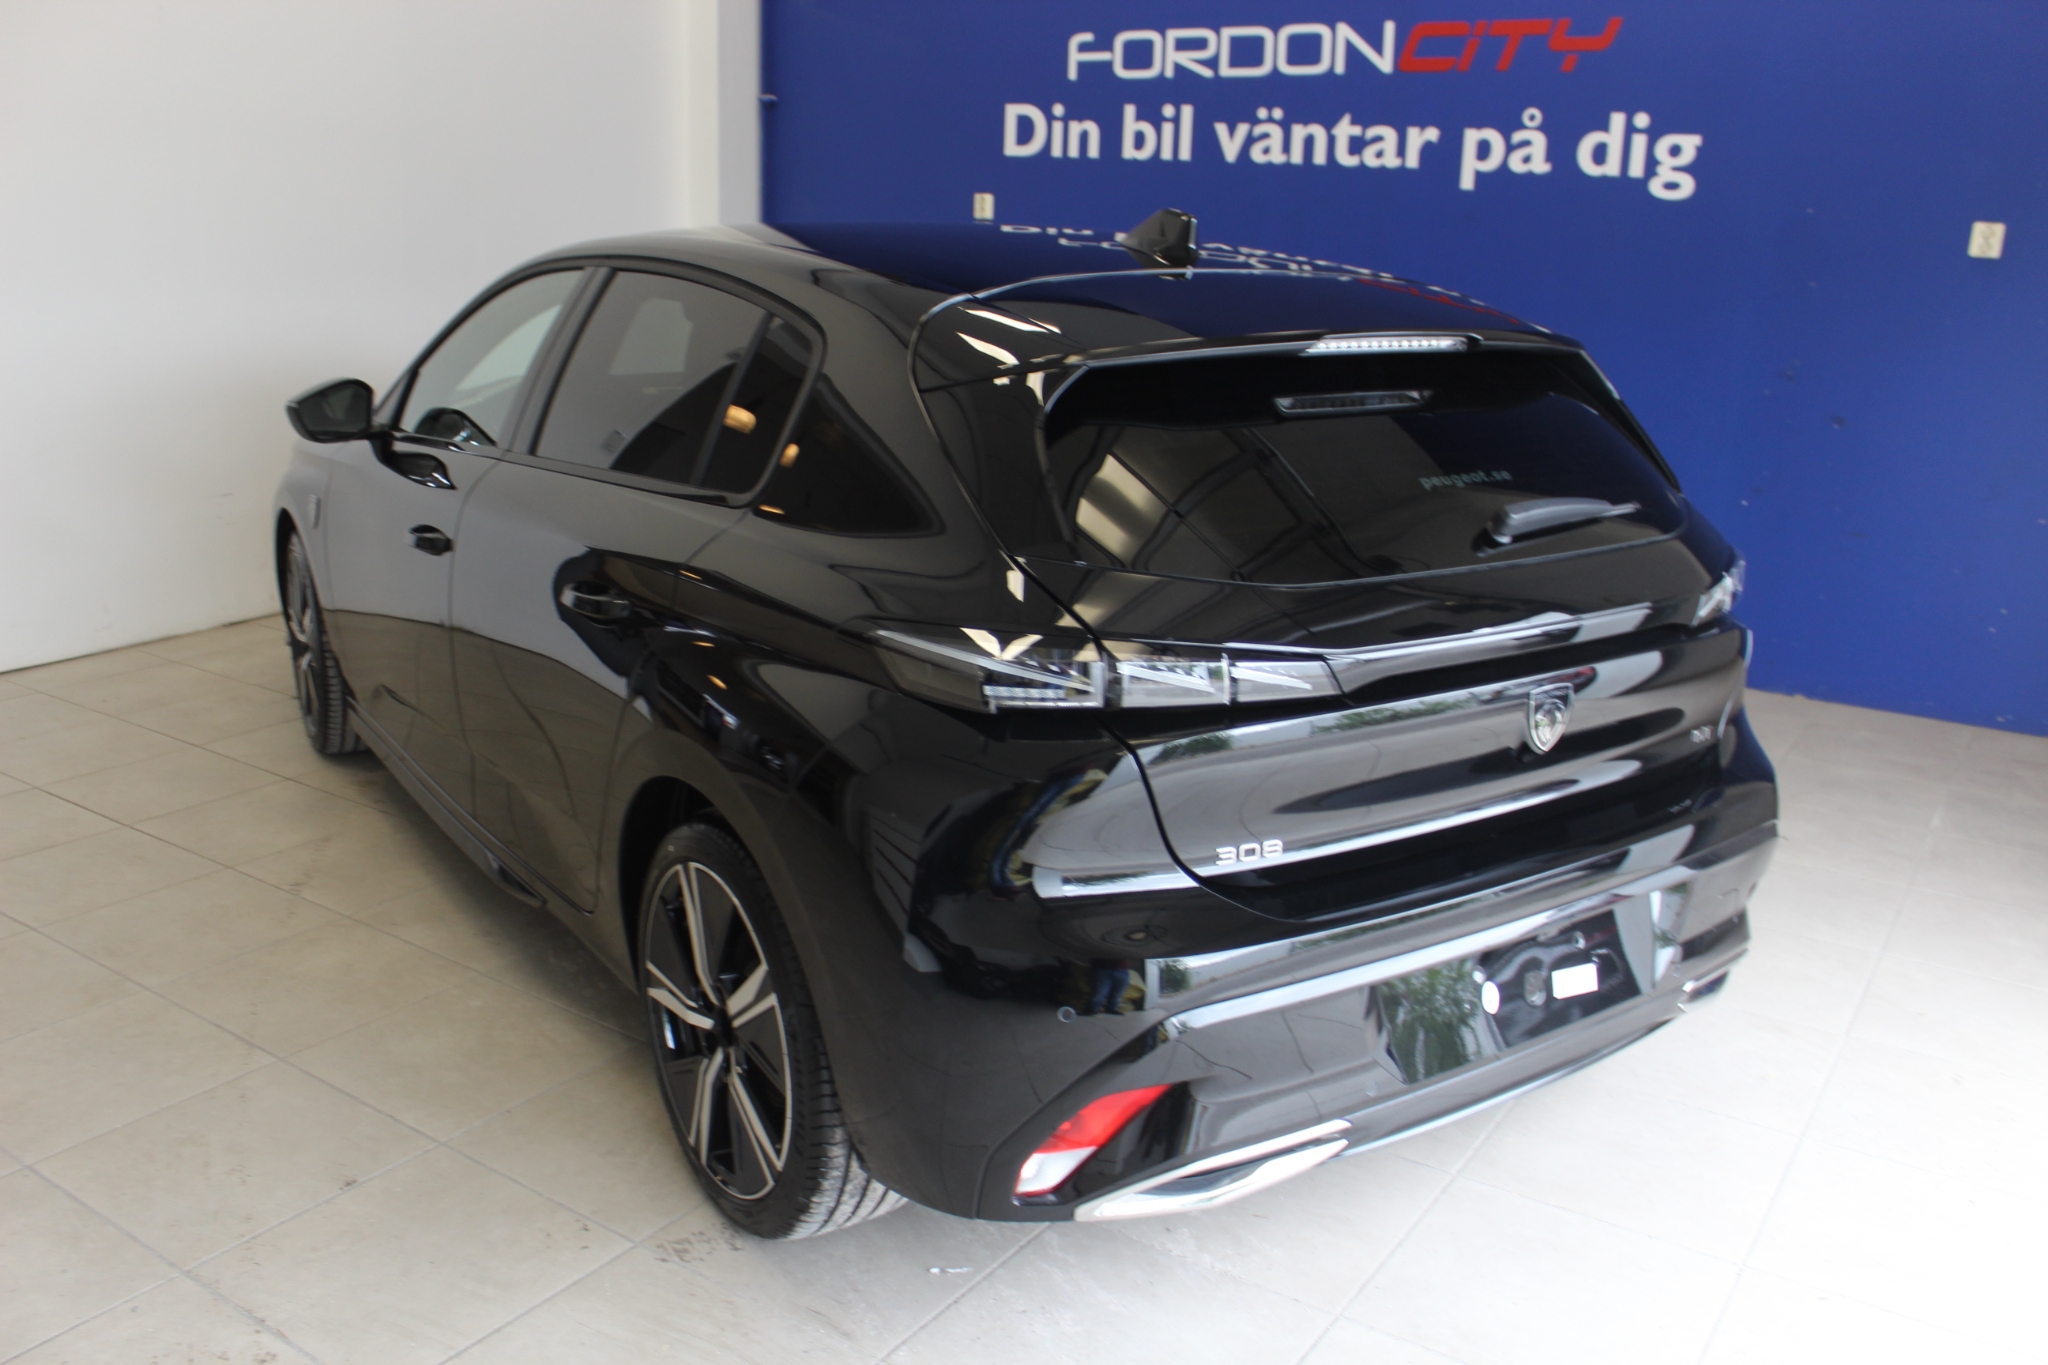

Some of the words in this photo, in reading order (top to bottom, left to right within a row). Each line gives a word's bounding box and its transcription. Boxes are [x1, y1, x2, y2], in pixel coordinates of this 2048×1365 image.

[1003, 102, 1101, 159] Din
[1121, 102, 1195, 161] bil
[1213, 106, 1441, 169] väntar
[1459, 106, 1553, 191] på
[1576, 111, 1704, 201] dig
[1418, 469, 1513, 491] peugeot.se
[1214, 838, 1284, 867] 308
